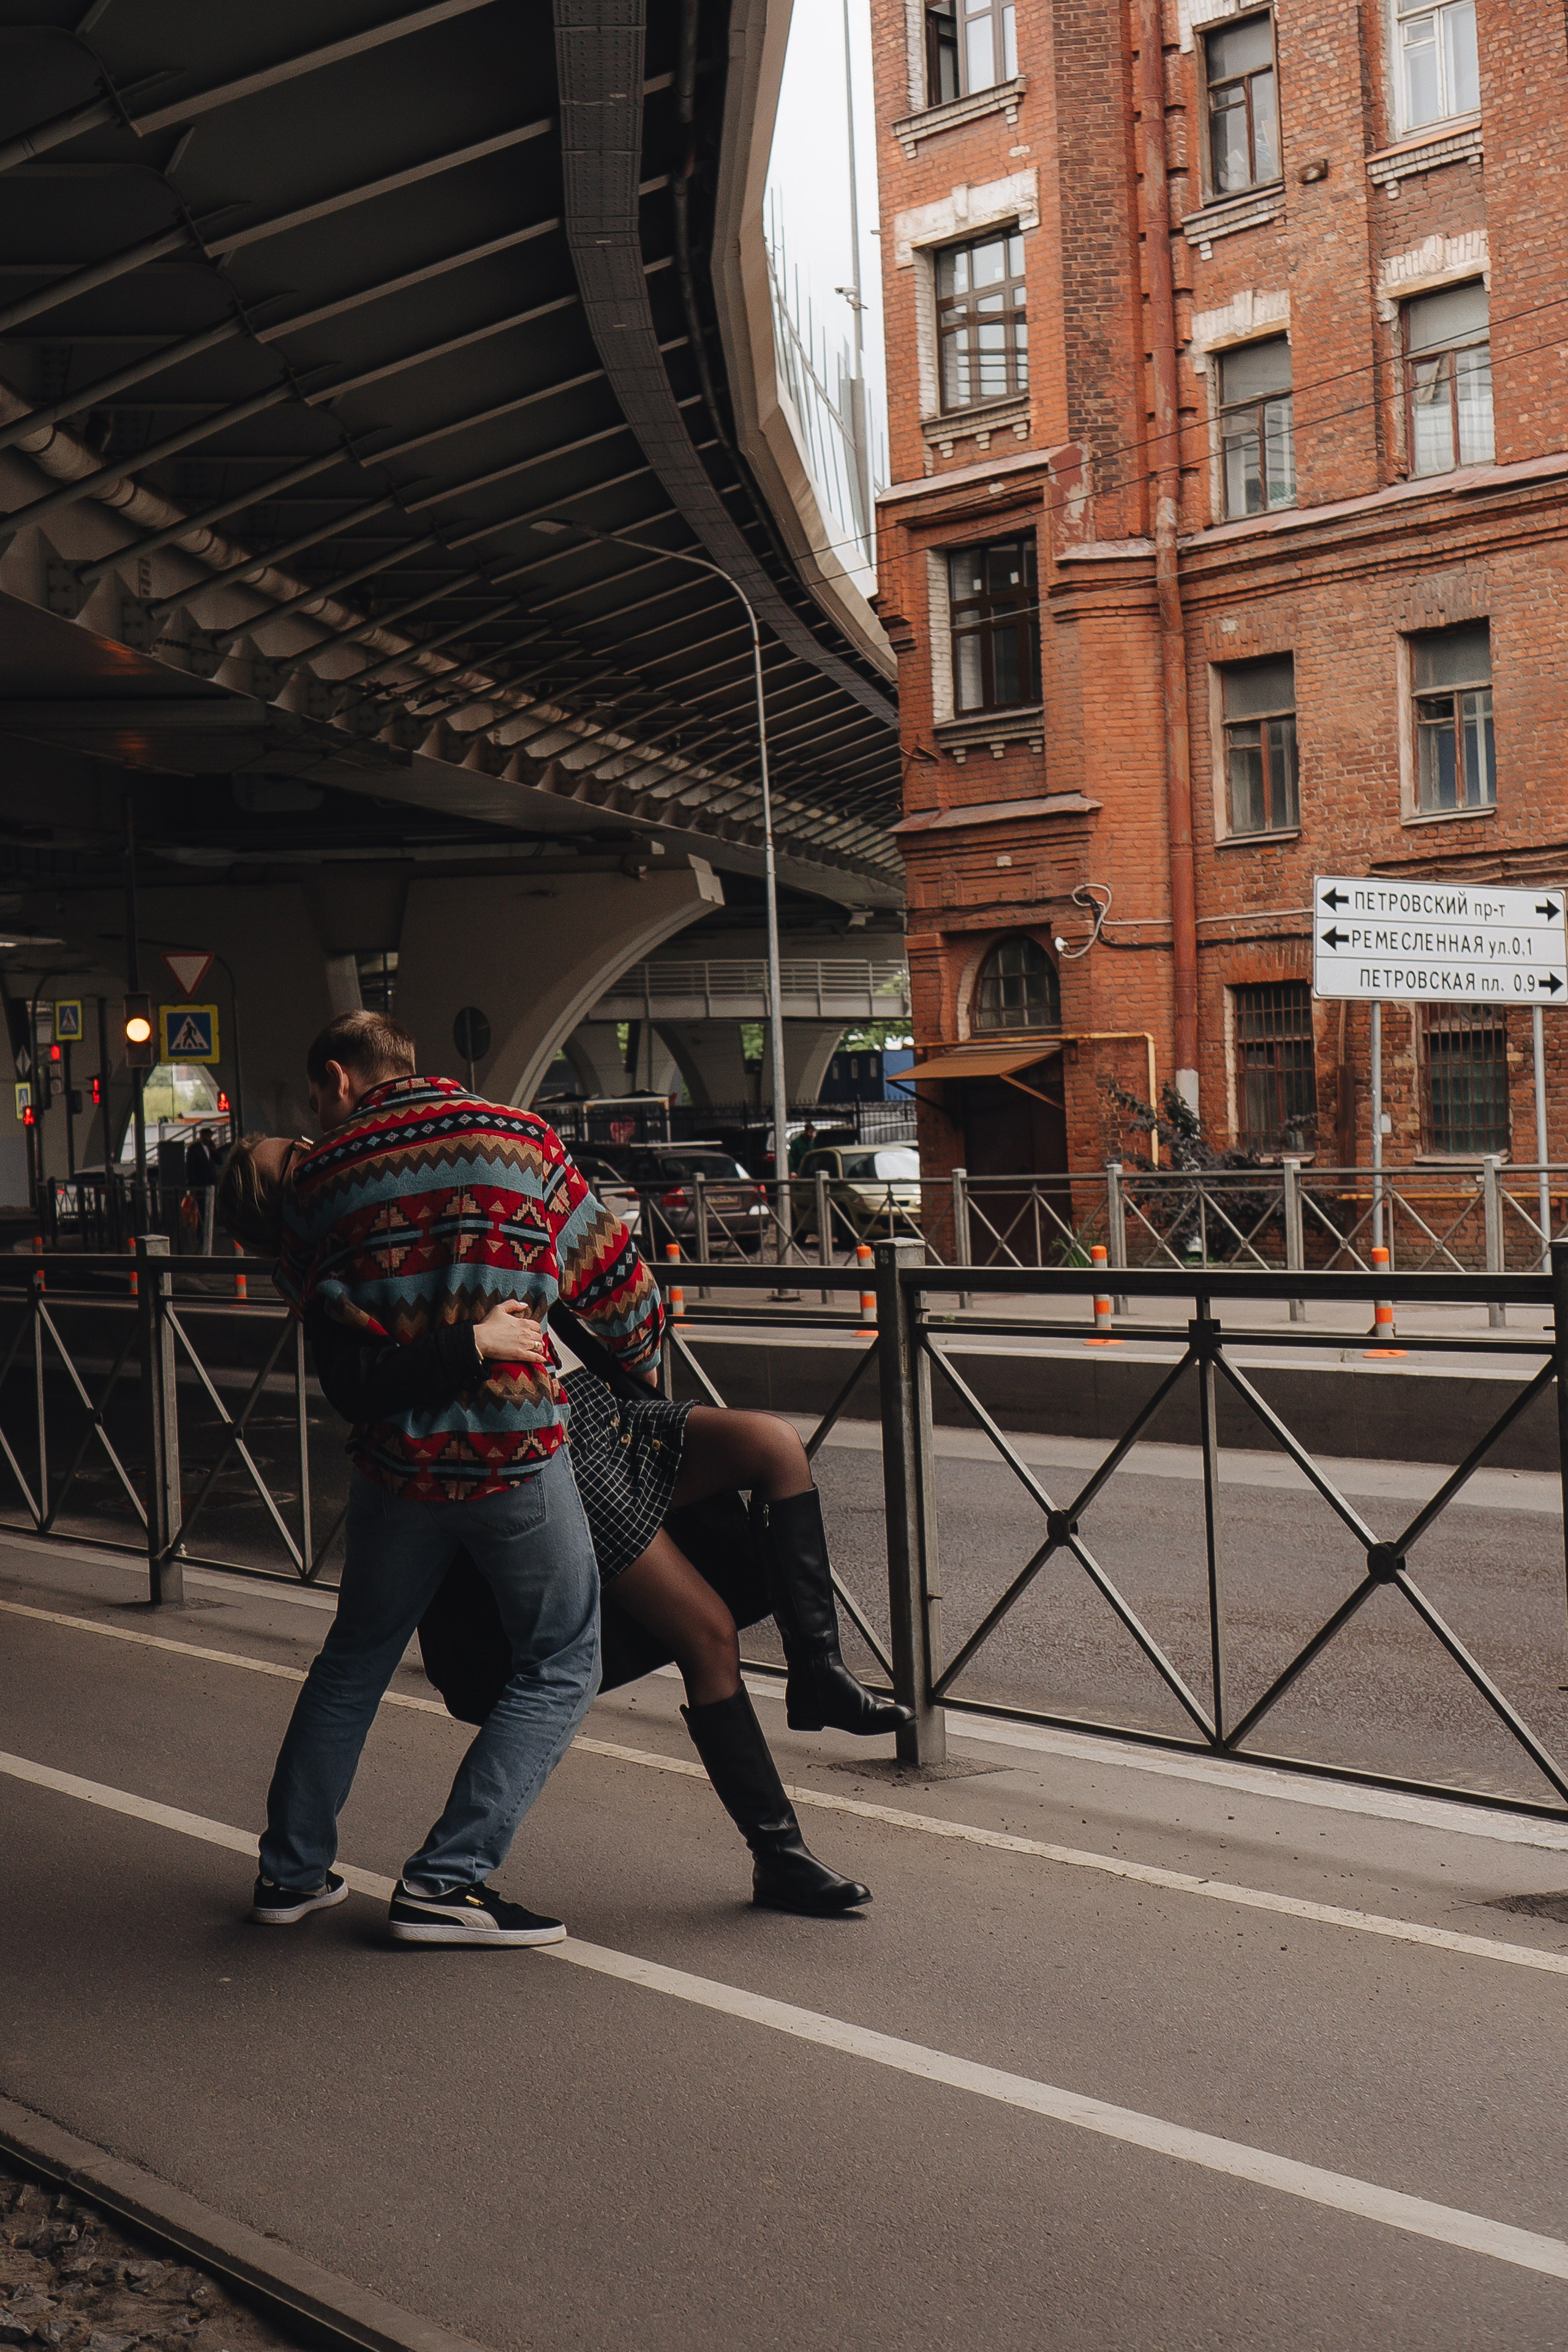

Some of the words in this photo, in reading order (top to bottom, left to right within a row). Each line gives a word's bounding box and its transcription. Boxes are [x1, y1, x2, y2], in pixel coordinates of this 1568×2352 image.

[1355, 891, 1468, 915] ПЕТРОВСКИЙ
[1474, 903, 1506, 921] пр-т
[1352, 929, 1484, 954] РЕМЕСЛЕННАЯ
[1360, 968, 1476, 991] ПЕТРОВСКАЯ
[1482, 978, 1504, 992] пл.
